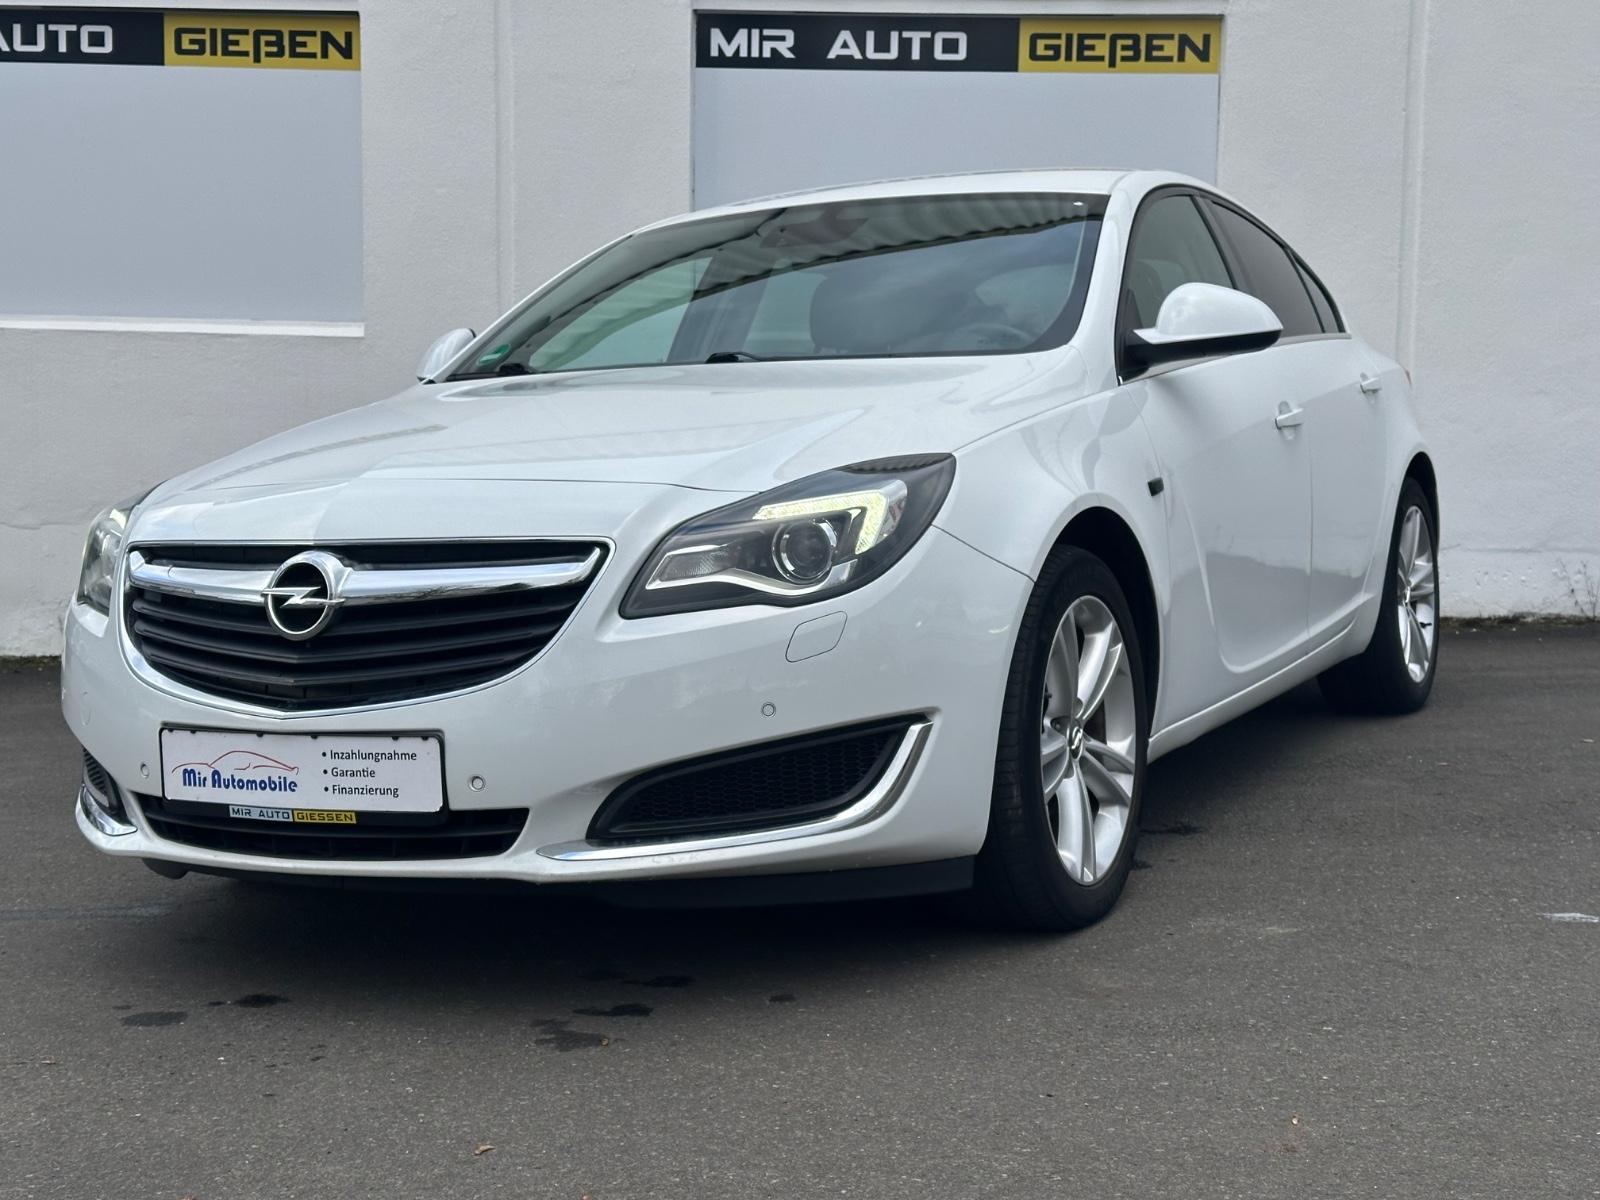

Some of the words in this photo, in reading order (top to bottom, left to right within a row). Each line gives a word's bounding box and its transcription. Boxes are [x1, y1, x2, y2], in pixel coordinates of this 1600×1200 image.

[0, 23, 113, 54] UTO
[709, 28, 796, 59] MIR
[826, 30, 968, 61] AUTO
[330, 749, 417, 763] Inzahlungnahme
[331, 767, 376, 778] Garantie
[182, 768, 207, 787] Mir
[211, 769, 298, 793] Automobile
[332, 784, 399, 798] Finanzierung
[231, 807, 252, 817] MIR
[259, 809, 290, 820] AUTO
[296, 811, 354, 822] GIESSEN
